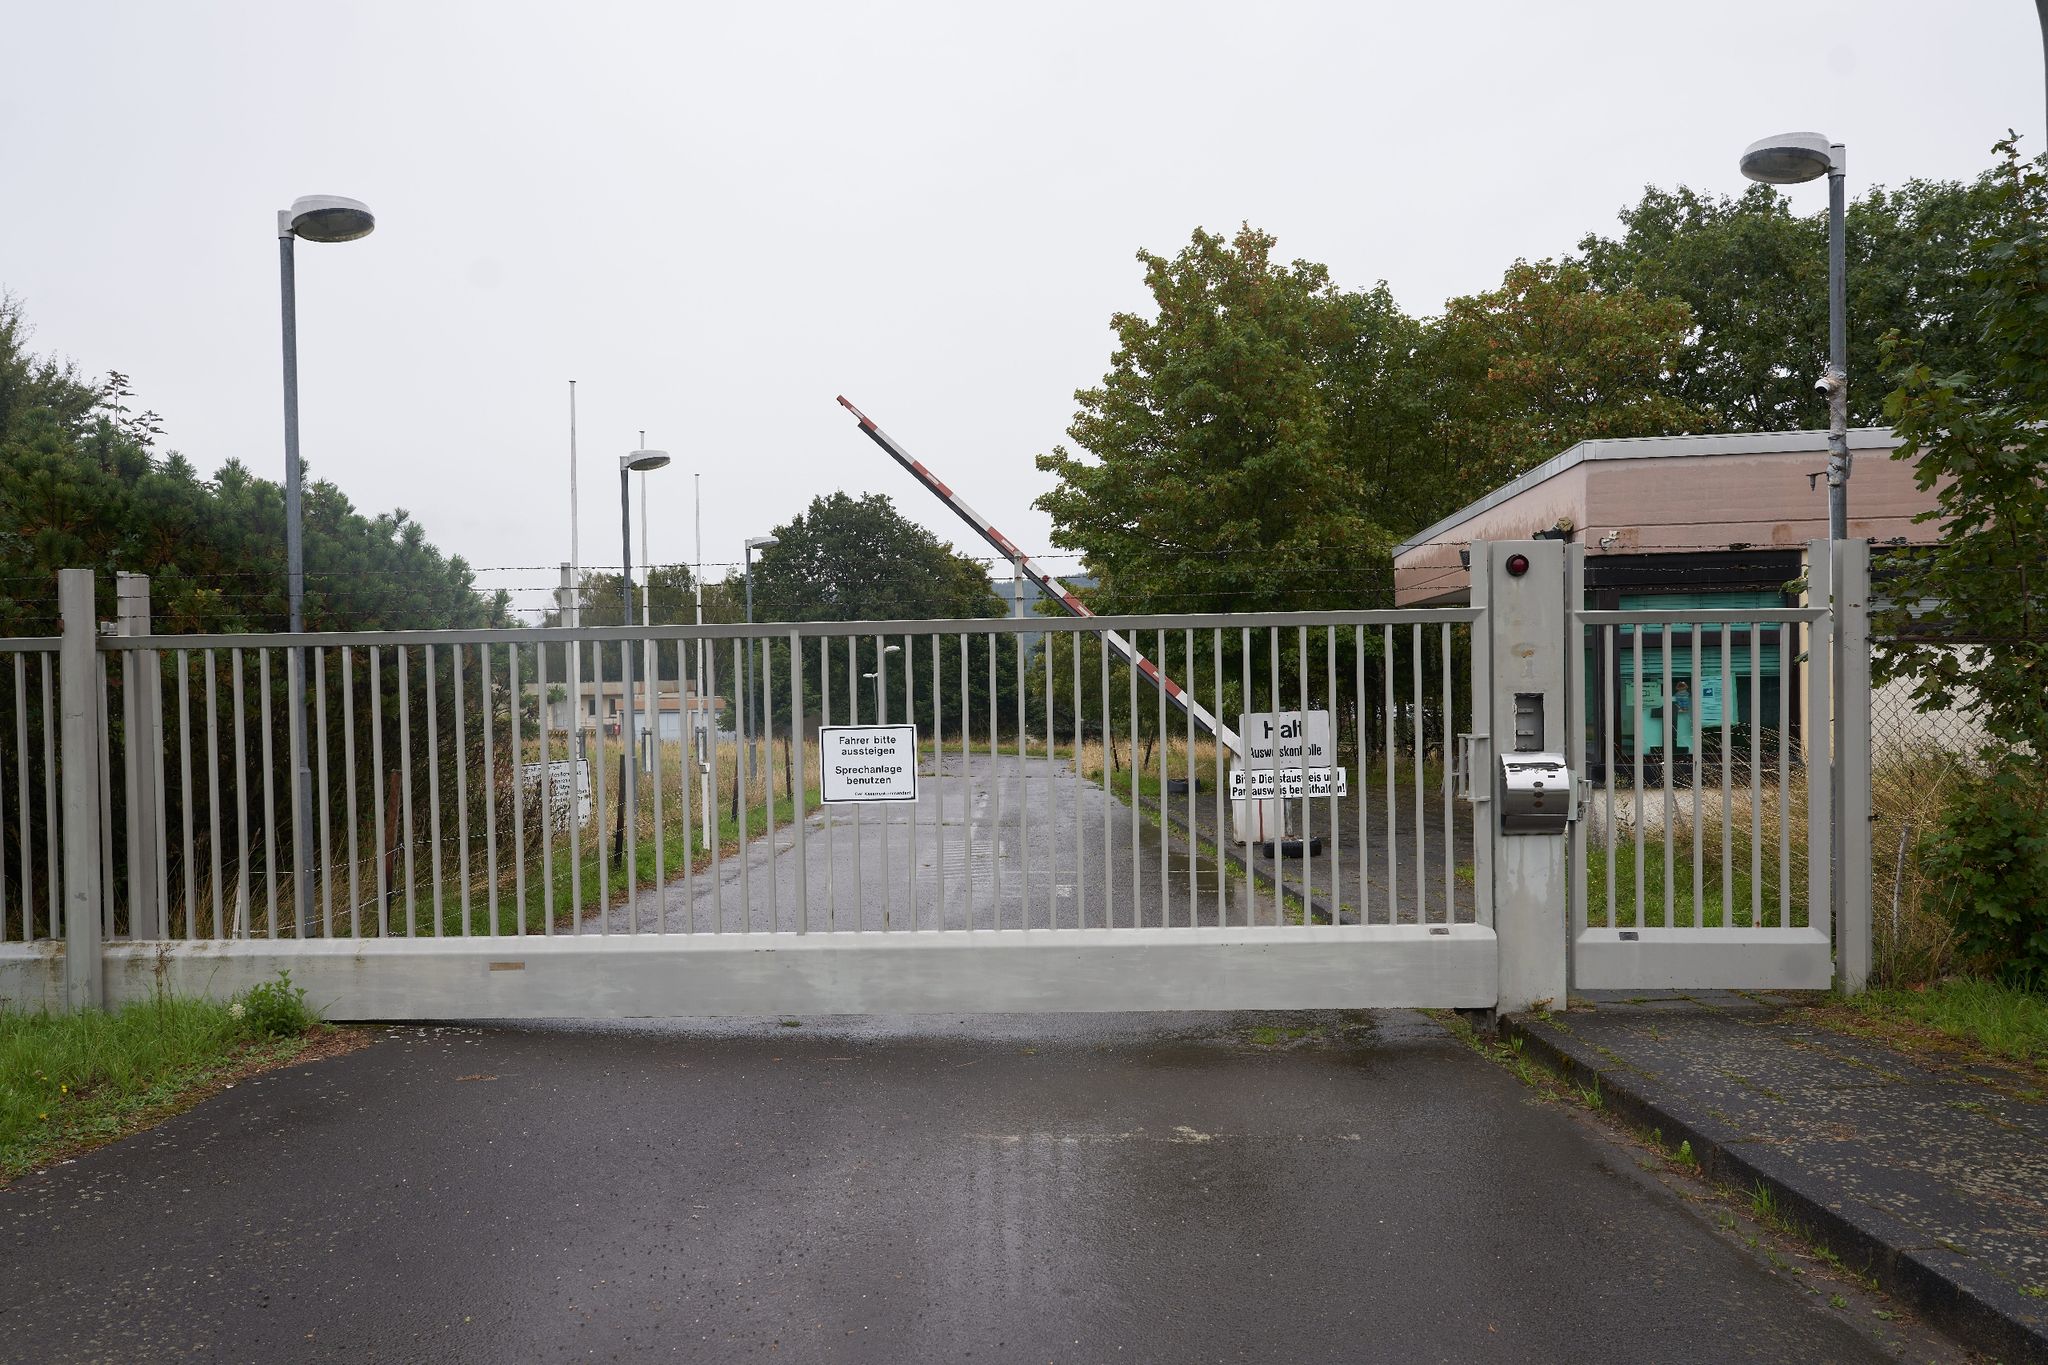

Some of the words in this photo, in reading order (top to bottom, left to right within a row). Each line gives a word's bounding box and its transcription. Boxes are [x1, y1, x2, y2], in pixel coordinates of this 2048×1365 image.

[839, 736, 870, 745] Fahrer
[873, 736, 897, 744] bitte
[841, 747, 895, 756] aussteigen
[1250, 744, 1322, 758] Auswskontolle
[835, 765, 902, 775] Sprechanlage
[846, 776, 891, 785] benutzen
[1235, 774, 1257, 784] Bie
[1258, 772, 1322, 784] Diestauseis
[1232, 786, 1287, 796] Parauswis
[1289, 783, 1346, 795] berithaltn!
